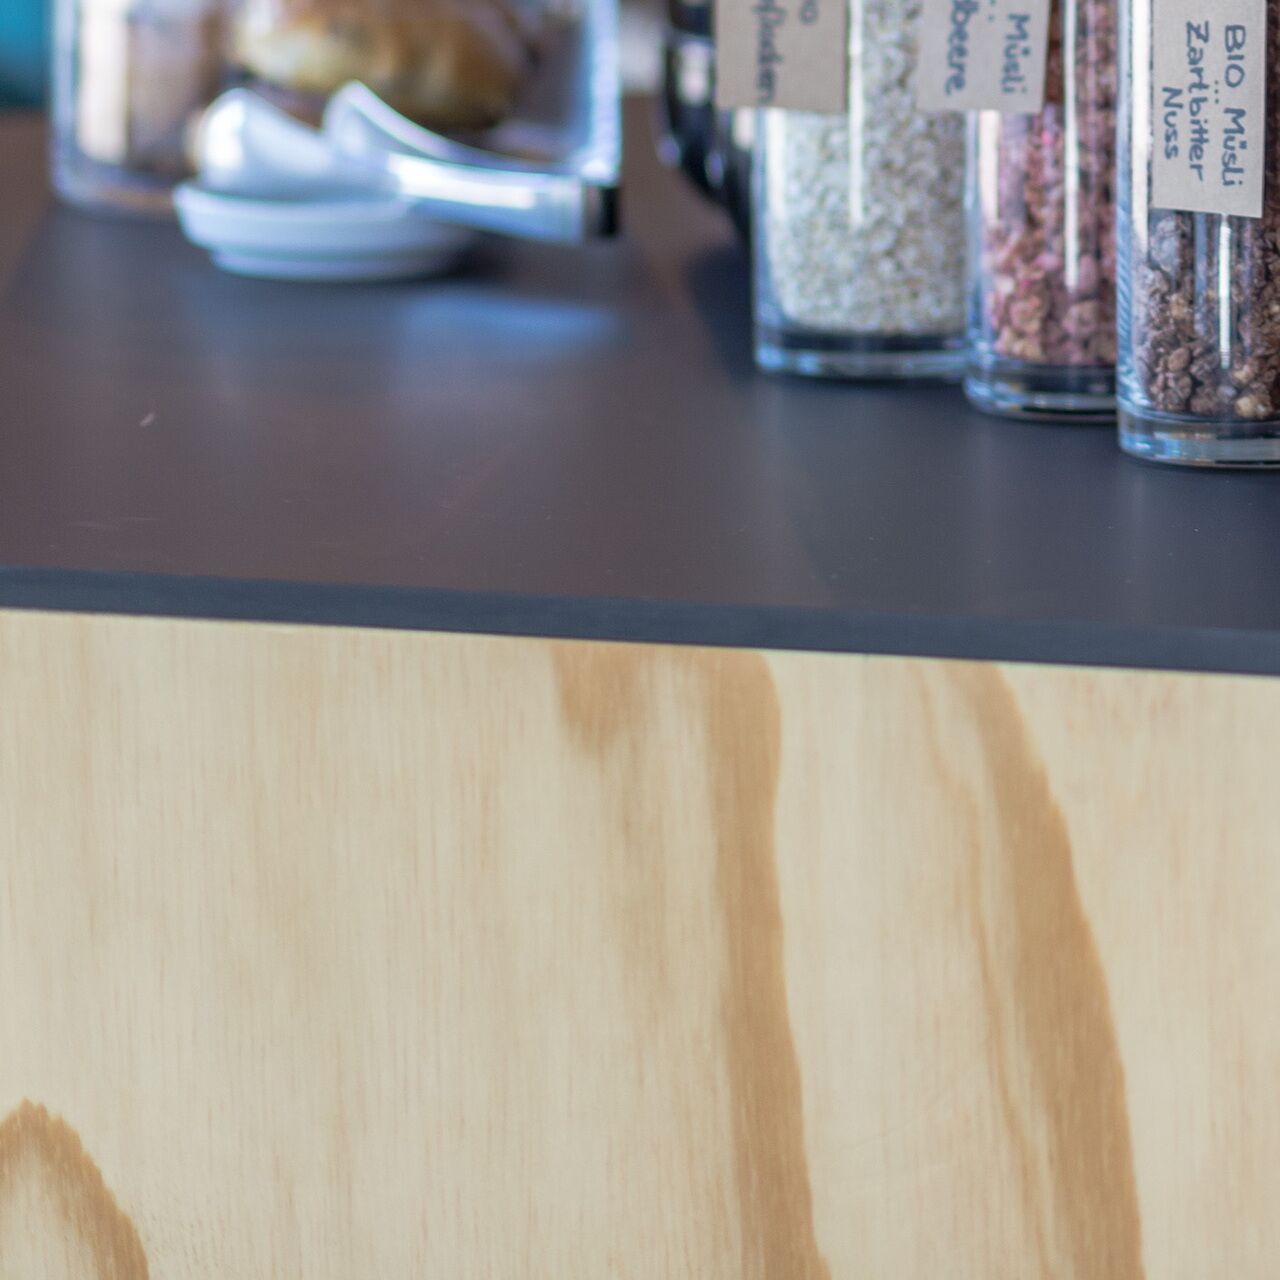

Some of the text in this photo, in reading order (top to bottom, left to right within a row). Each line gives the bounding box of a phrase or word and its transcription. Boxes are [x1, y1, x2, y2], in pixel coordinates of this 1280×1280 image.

[1002, 14, 1031, 94] Müsli
[1186, 20, 1210, 182] Zartbitter
[1222, 25, 1247, 186] BIO Müsli
[1162, 87, 1184, 160] Nuss
